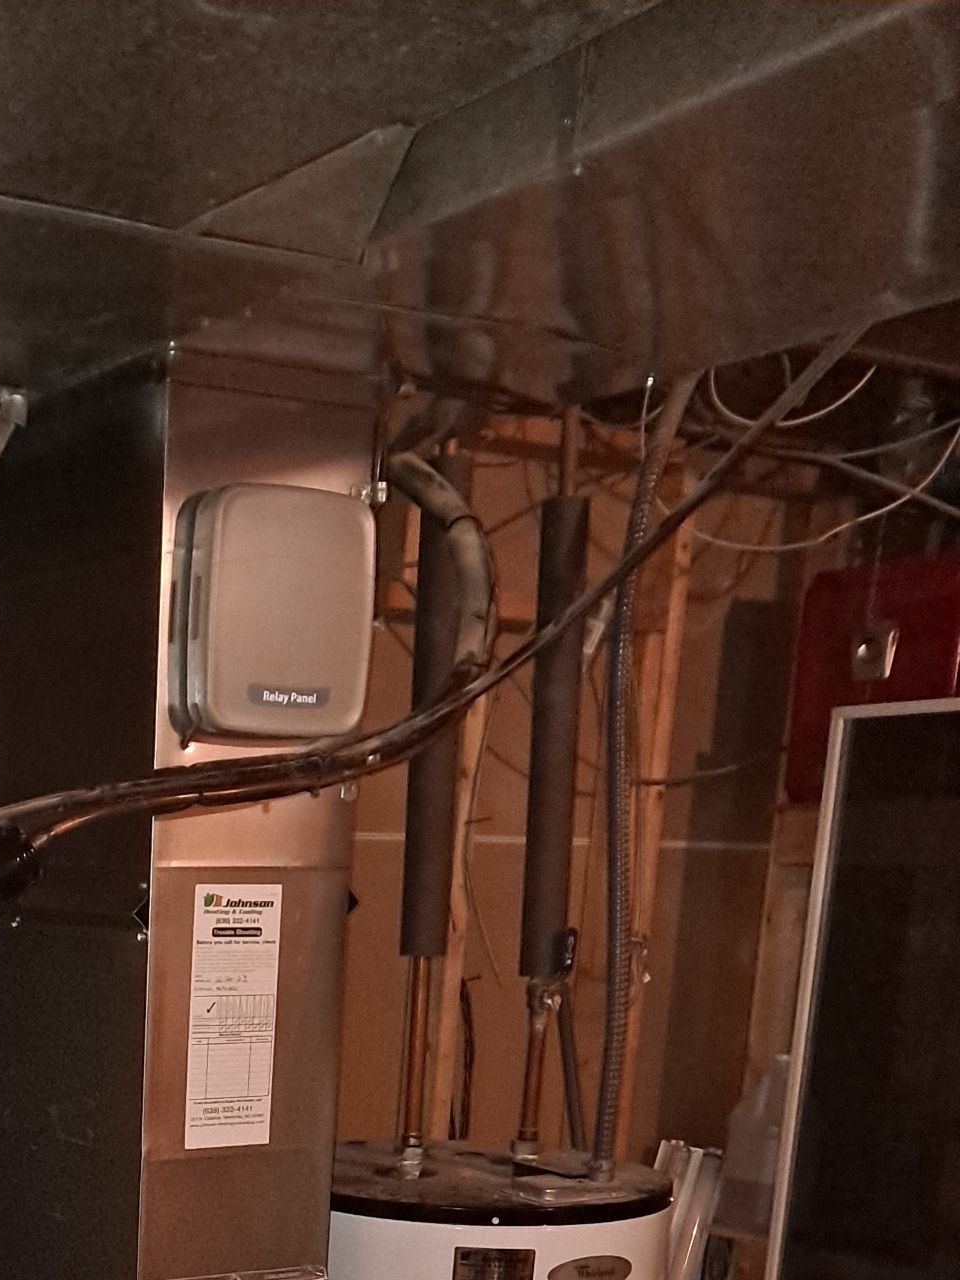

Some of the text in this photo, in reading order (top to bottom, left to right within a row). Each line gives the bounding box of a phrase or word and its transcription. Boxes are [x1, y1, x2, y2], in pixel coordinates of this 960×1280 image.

[263, 690, 317, 705] Relay Panel
[223, 898, 274, 908] Johnson
